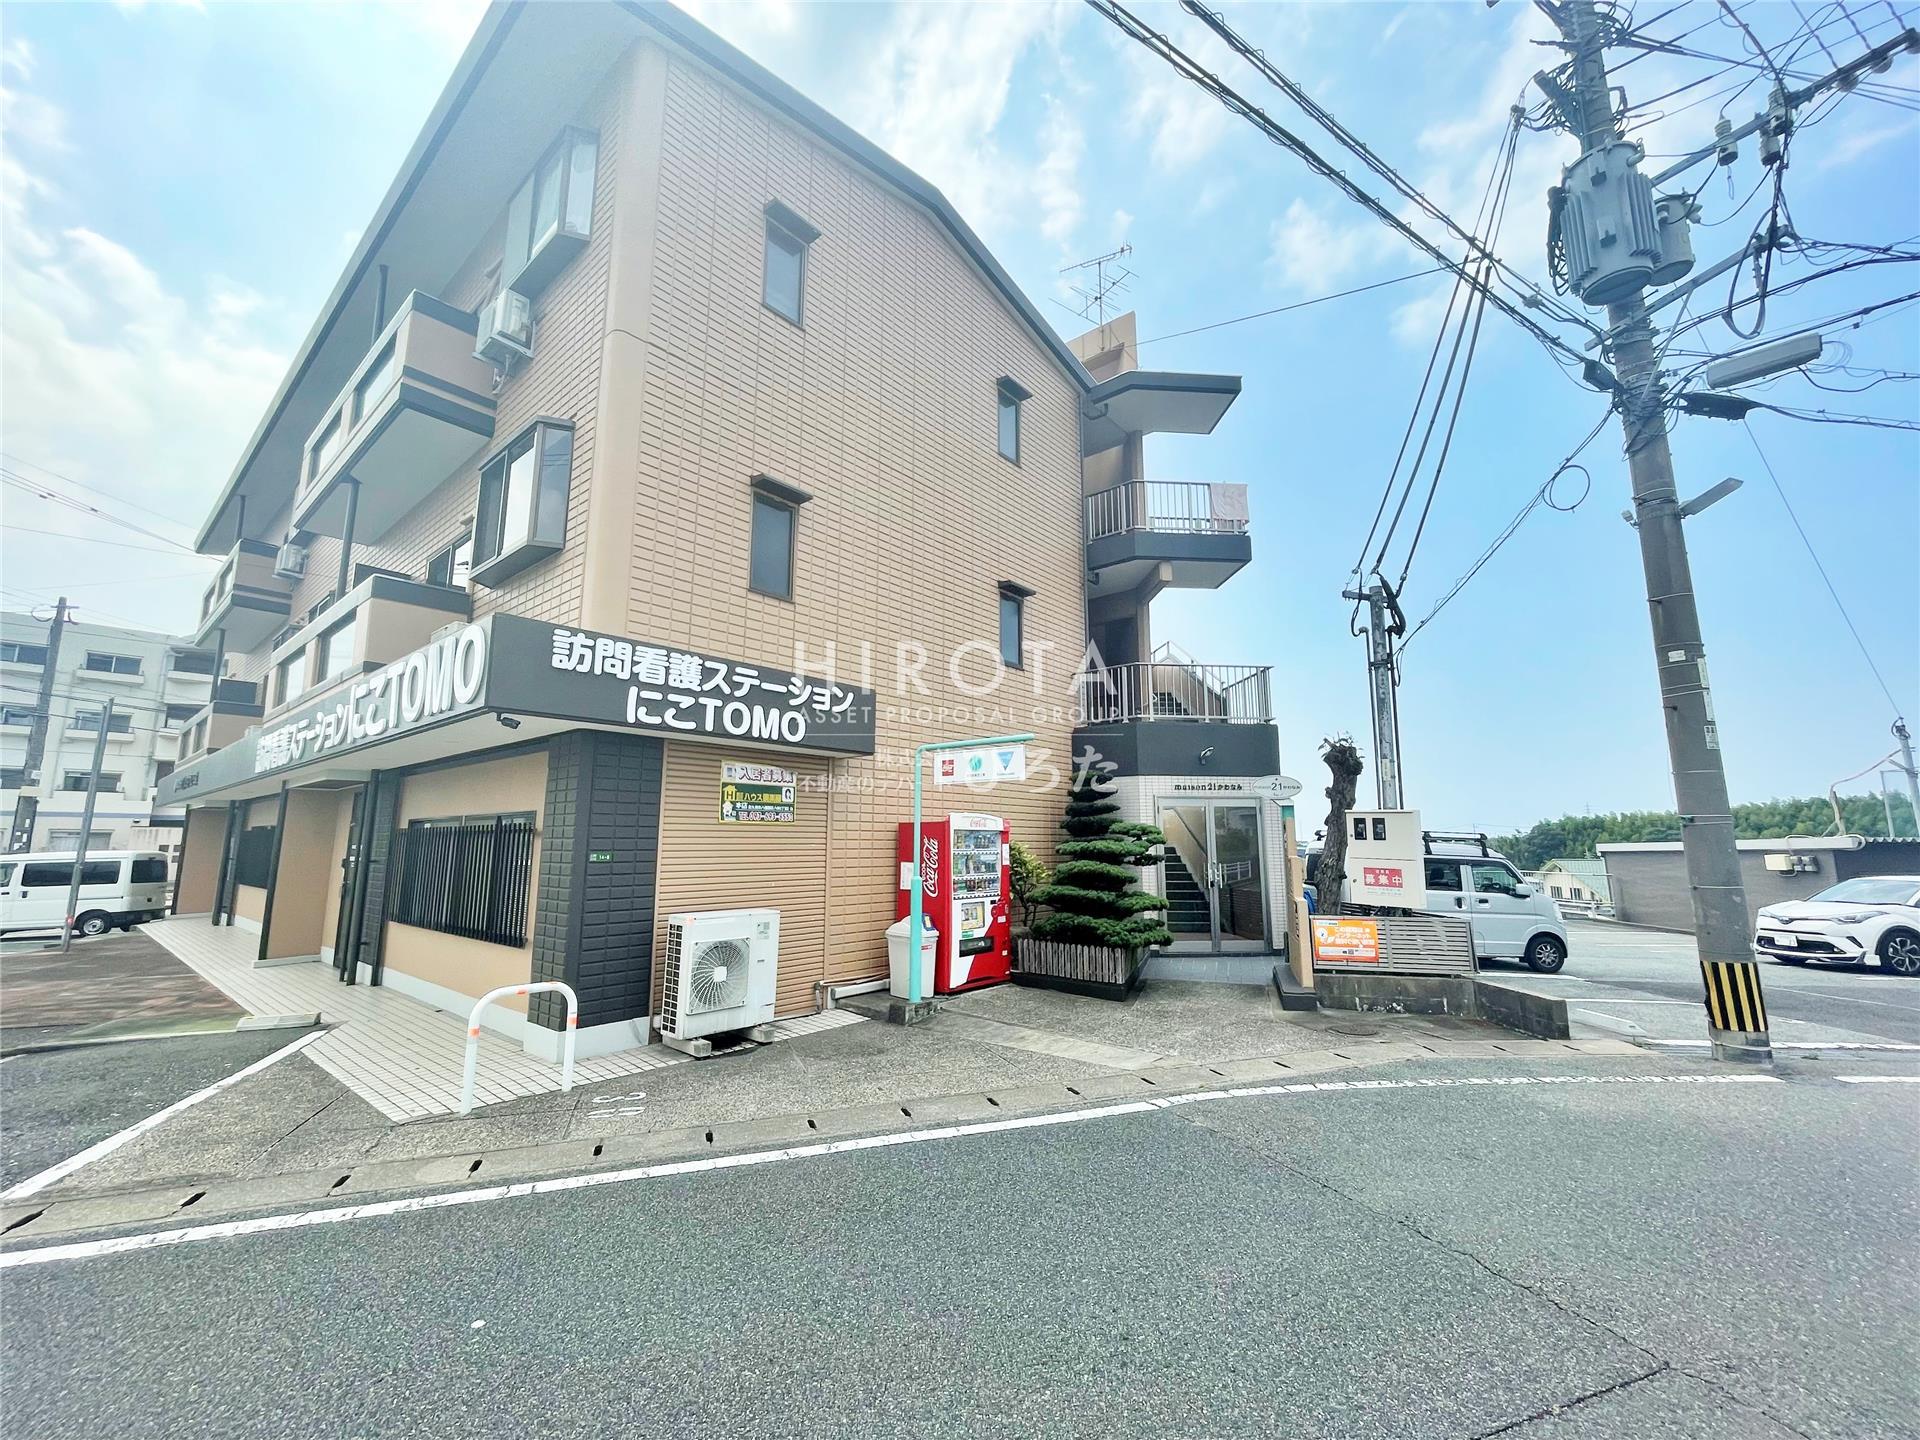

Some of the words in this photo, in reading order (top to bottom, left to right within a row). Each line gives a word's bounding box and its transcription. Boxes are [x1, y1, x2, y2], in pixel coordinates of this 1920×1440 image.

[552, 628, 855, 713] 訪問看護ステーション
[626, 685, 806, 743] にこTOMO
[1271, 782, 1284, 791] 21
[923, 834, 939, 898] Coca-Cola
[1365, 873, 1402, 887] 募集中
